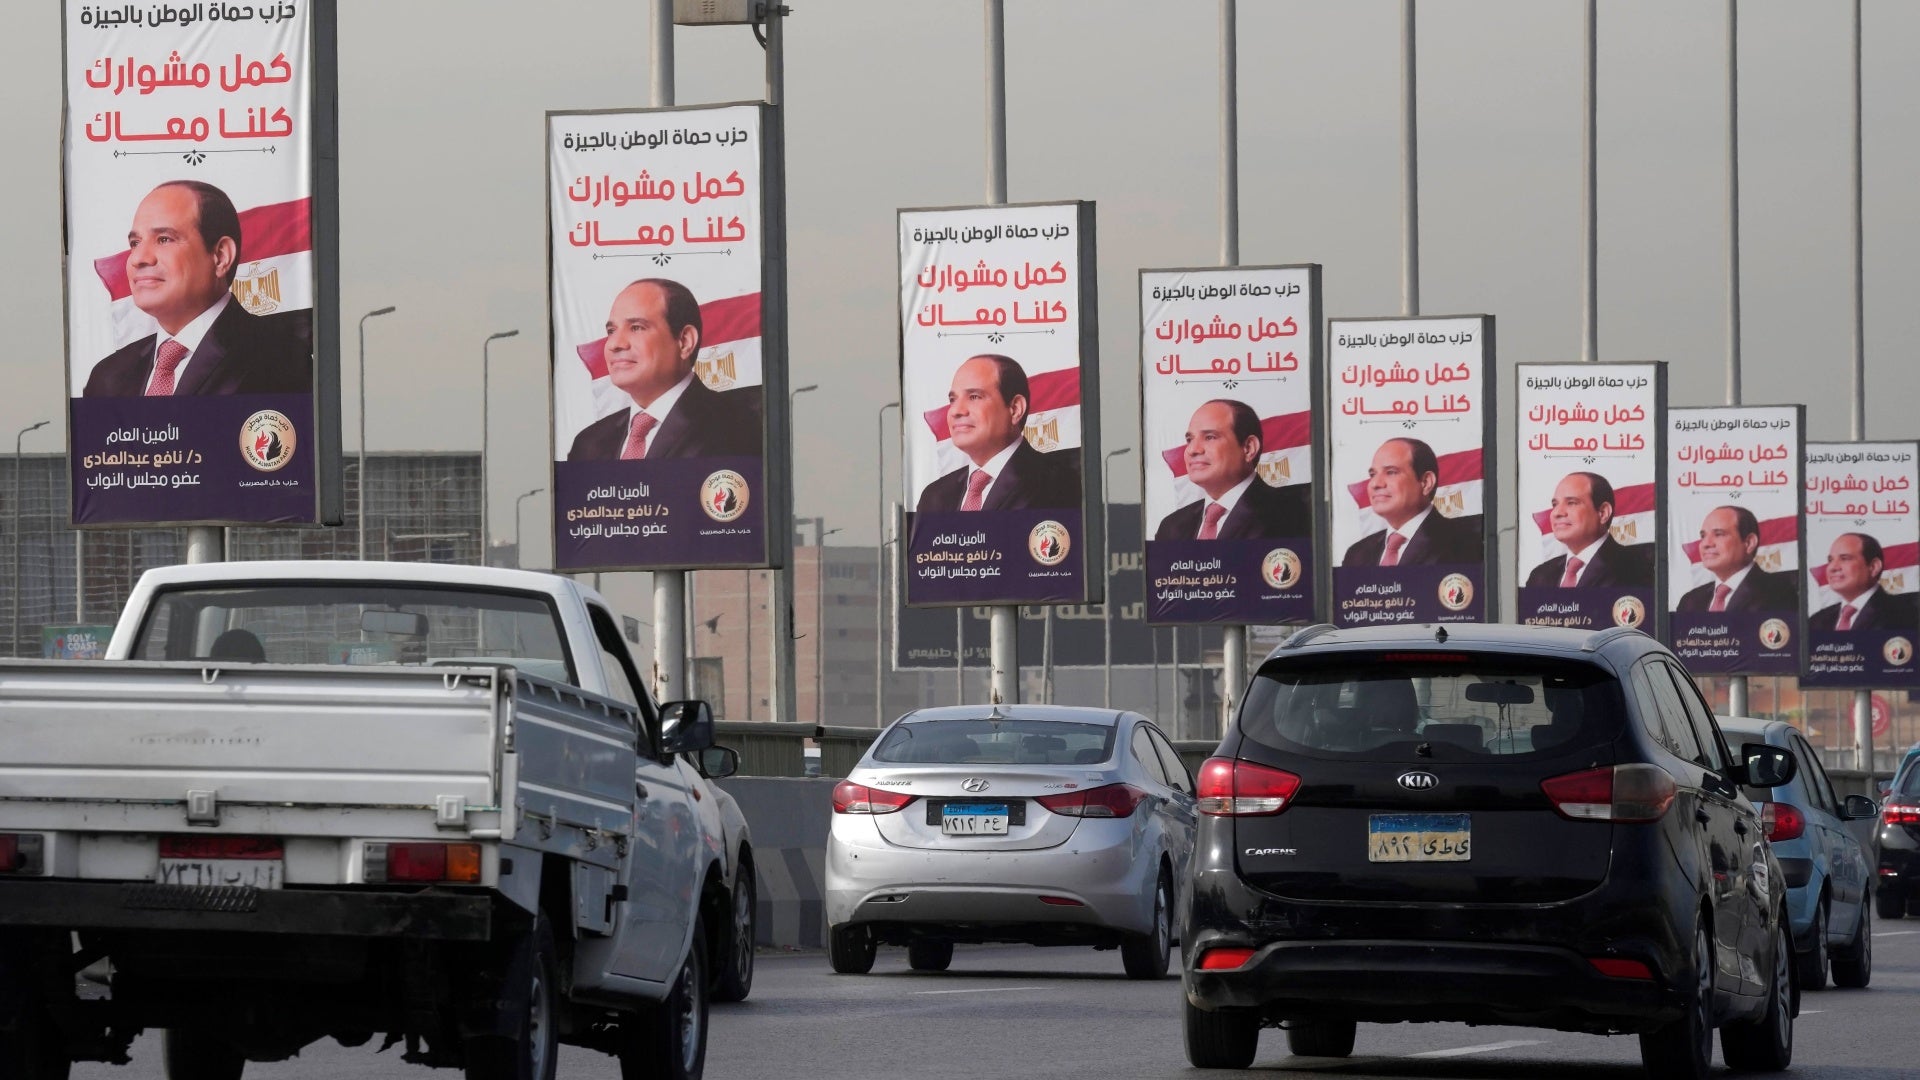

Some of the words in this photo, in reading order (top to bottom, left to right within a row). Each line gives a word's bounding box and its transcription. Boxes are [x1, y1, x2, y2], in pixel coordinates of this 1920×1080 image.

[81, 5, 142, 29] بالجيزة
[148, 3, 202, 27] الوطن
[209, 2, 253, 22] حماة
[259, 1, 295, 24] حزب
[86, 51, 210, 95] مشوارك
[220, 52, 291, 92] كمل
[219, 107, 293, 138] كلنا
[564, 132, 616, 152] بالجيزة
[621, 130, 668, 150] الوطن
[673, 129, 711, 145] حماة
[716, 127, 747, 146] حزب
[569, 170, 675, 207] مشوارك
[683, 170, 744, 204] كمل
[683, 216, 745, 243] كلنا
[914, 227, 957, 245] بالجيزة
[962, 225, 1001, 243] الوطن
[1006, 225, 1038, 239] حماة
[1042, 224, 1069, 240] حزب
[917, 260, 1007, 293] مشوارك
[1014, 261, 1066, 290] كمل
[1153, 286, 1195, 302] بالجيزة
[1198, 284, 1236, 300] الوطن
[1240, 284, 1271, 296] حماة
[1275, 283, 1300, 297] حزب
[1014, 300, 1067, 323] كلنا
[1156, 315, 1241, 344] مشوارك
[1248, 316, 1297, 342] كمل
[1339, 334, 1376, 348] بالجيزة
[1380, 333, 1414, 347] الوطن
[1418, 333, 1446, 344] حماة
[1449, 332, 1472, 345] حزب
[1247, 352, 1298, 372] كلنا
[1342, 361, 1419, 387] مشوارك
[1425, 362, 1470, 386] كمل
[1598, 377, 1623, 387] حماة
[1527, 377, 1561, 390] بالجيزة
[1564, 377, 1595, 389] الوطن
[1626, 376, 1647, 389] حزب
[1529, 402, 1599, 425] مشوارك
[1604, 405, 1645, 425] كمل
[1675, 420, 1708, 431] بالجيزة
[1711, 419, 1740, 431] الوطن
[1743, 419, 1767, 429] حماة
[1770, 419, 1790, 430] حزب
[107, 428, 139, 445] العام
[142, 423, 178, 444] الأمين
[154, 451, 182, 467] نافع
[1678, 442, 1744, 464] مشوارك
[1749, 444, 1787, 463] كمل
[87, 473, 123, 489] النواب
[127, 472, 168, 489] مجلس
[172, 472, 200, 488] عضو
[587, 486, 615, 501] العام
[618, 482, 649, 500] الأمين
[627, 505, 652, 519] نافع
[570, 524, 602, 538] النواب
[604, 523, 639, 538] مجلس
[642, 522, 667, 537] عضو
[933, 534, 957, 546] العام
[967, 550, 987, 563] نافع
[919, 566, 946, 579] النواب
[948, 566, 977, 579] مجلس
[980, 565, 1000, 578] عضو
[1171, 560, 1193, 572] العام
[1203, 575, 1223, 586] نافع
[1157, 589, 1183, 601] النواب
[1185, 589, 1213, 600] مجلس
[1215, 588, 1235, 600] عضو
[67, 642, 97, 651] COAST
[1405, 776, 1433, 787] KIA
[1245, 848, 1297, 856] CARENS
